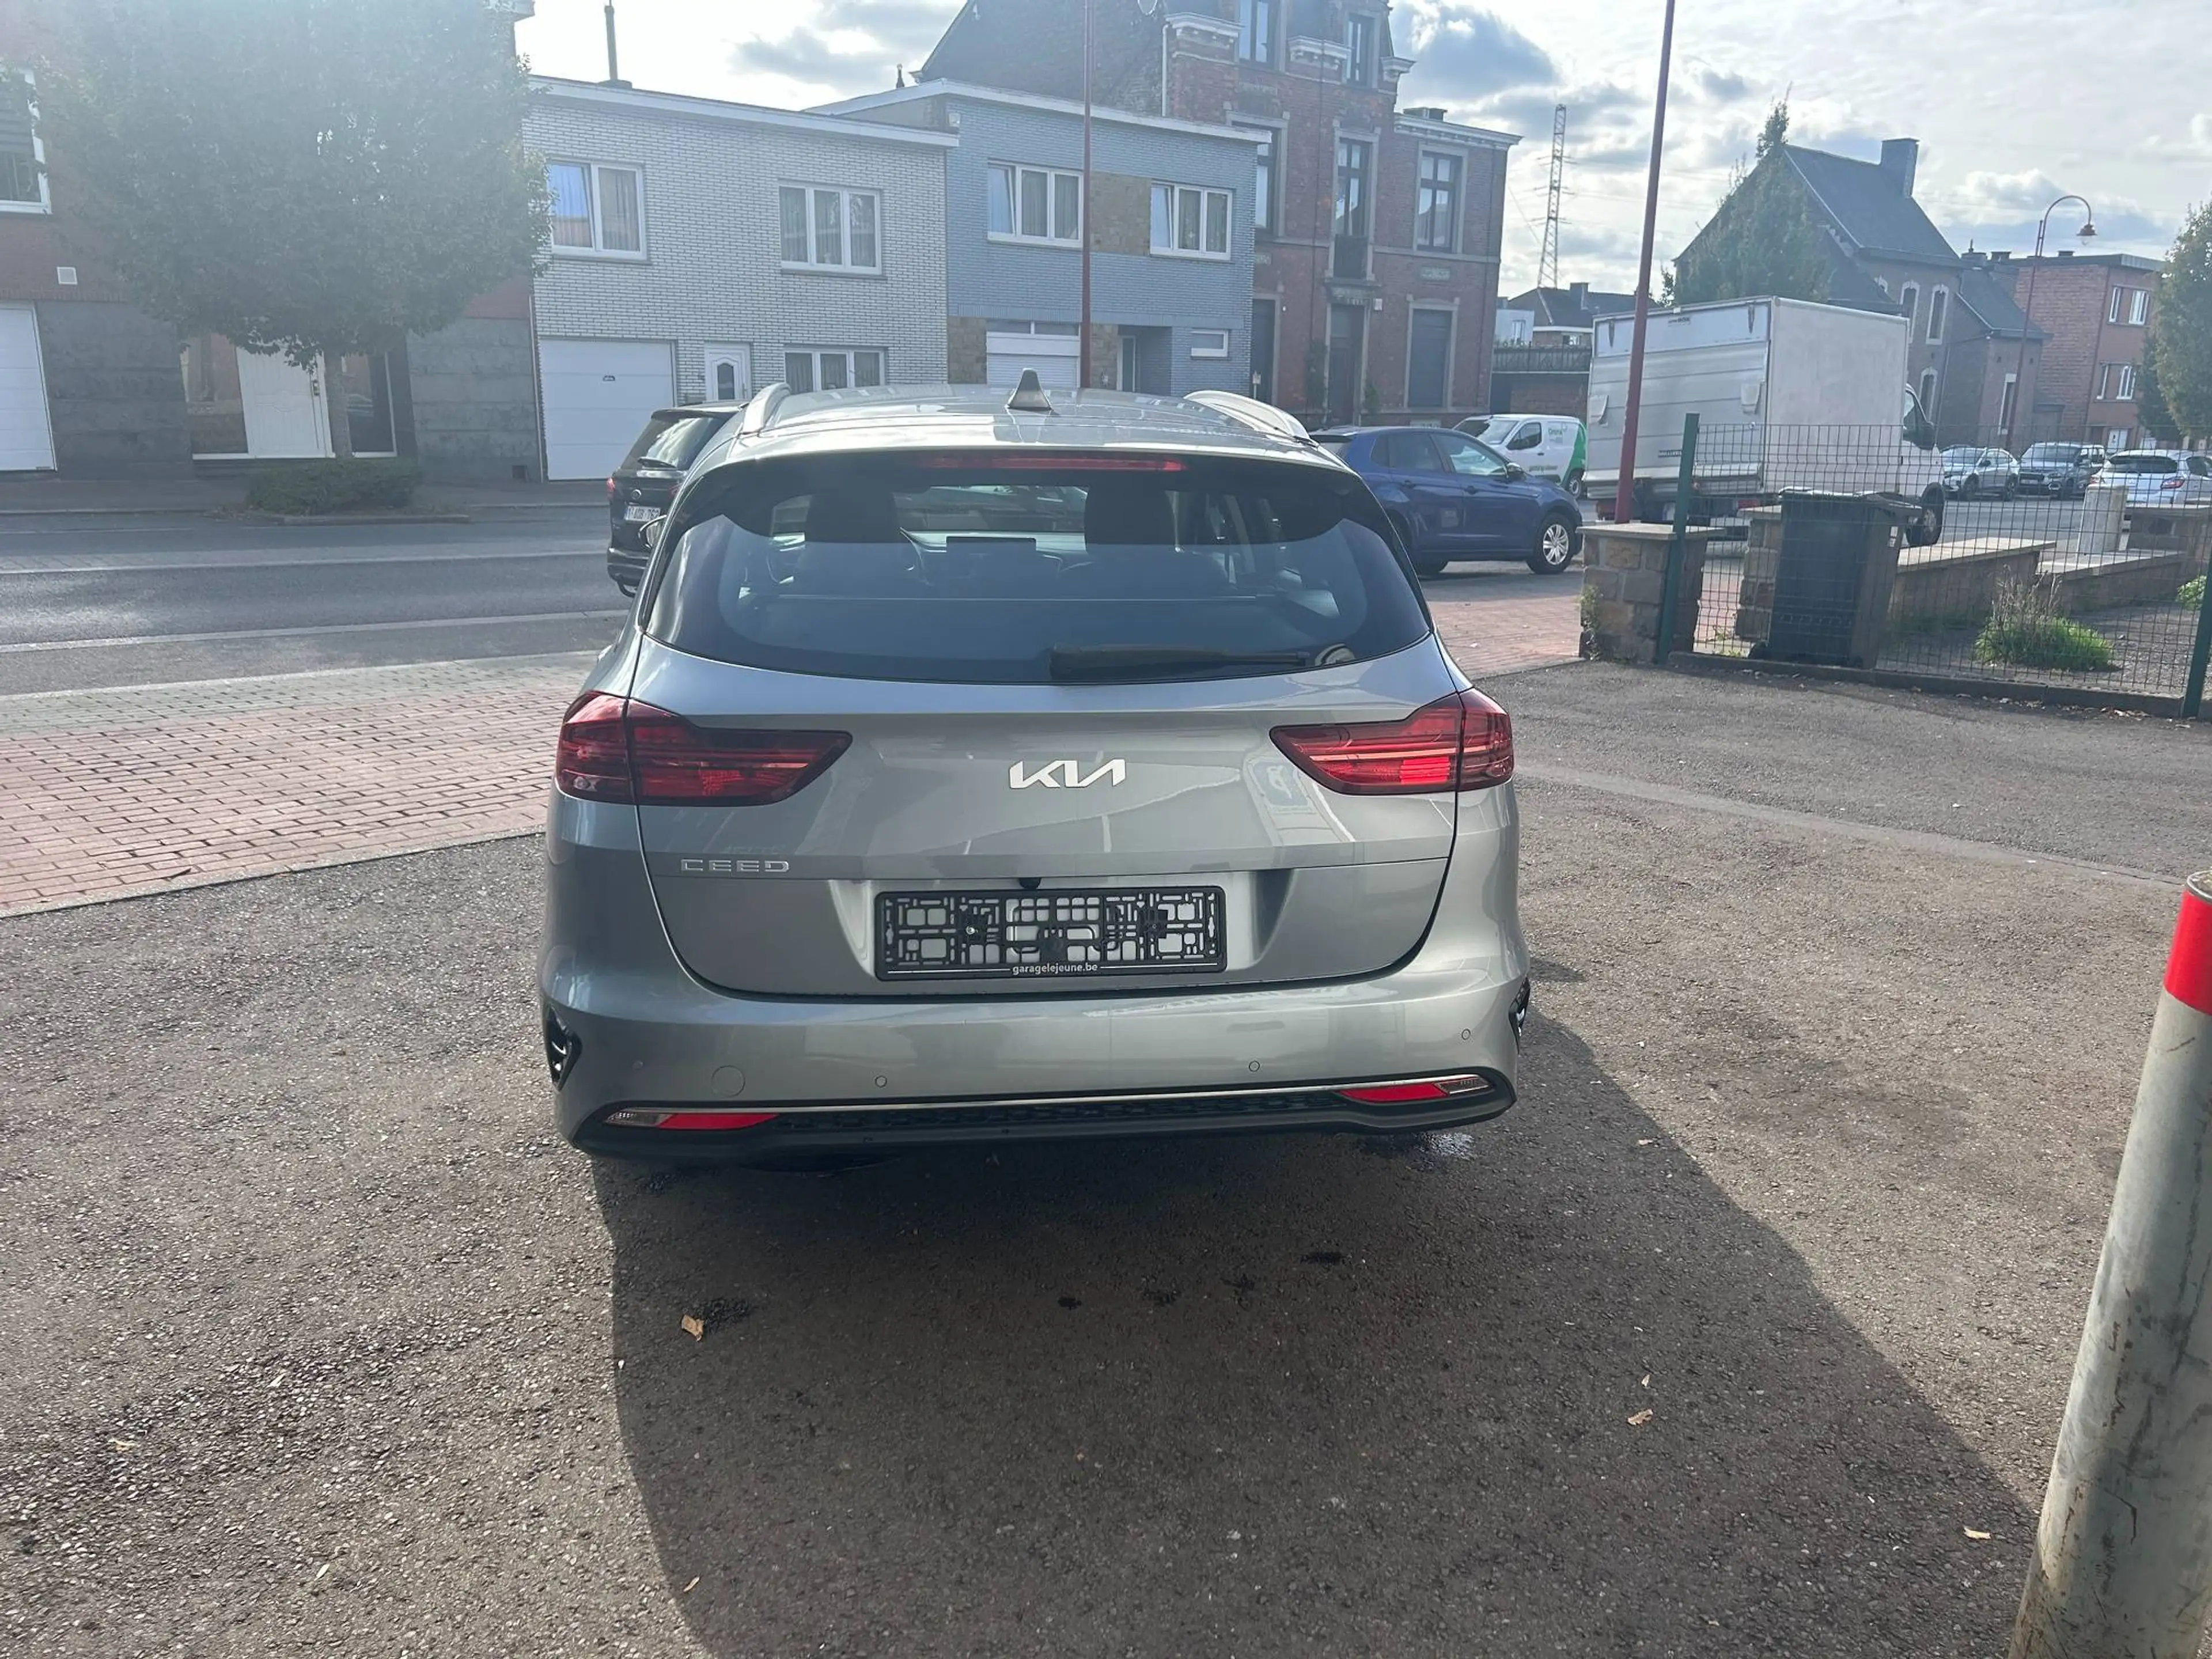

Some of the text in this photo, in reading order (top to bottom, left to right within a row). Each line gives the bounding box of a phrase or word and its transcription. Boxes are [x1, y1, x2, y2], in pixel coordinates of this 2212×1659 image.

[1009, 758, 1126, 789] KIA
[680, 859, 789, 872] CEED
[1012, 963, 1098, 975] garagelejeune.be
